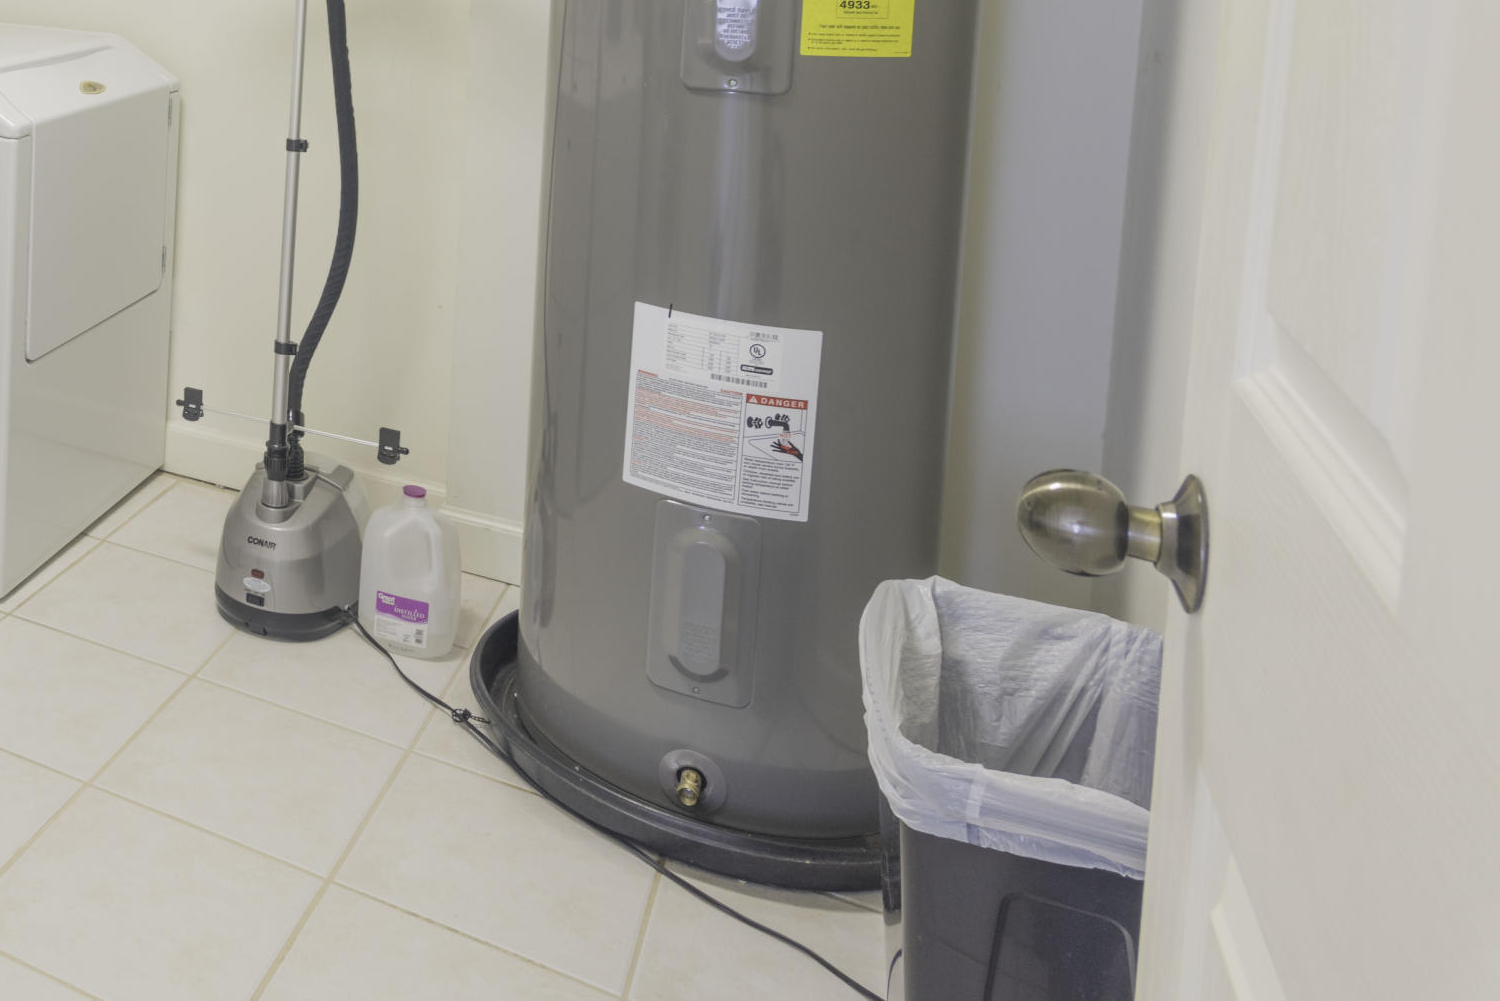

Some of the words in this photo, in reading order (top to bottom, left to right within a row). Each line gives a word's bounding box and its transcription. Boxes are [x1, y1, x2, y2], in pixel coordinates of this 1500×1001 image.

[839, 0, 871, 10] 4933
[760, 397, 806, 408] DANGER
[247, 536, 276, 550] CONAIR
